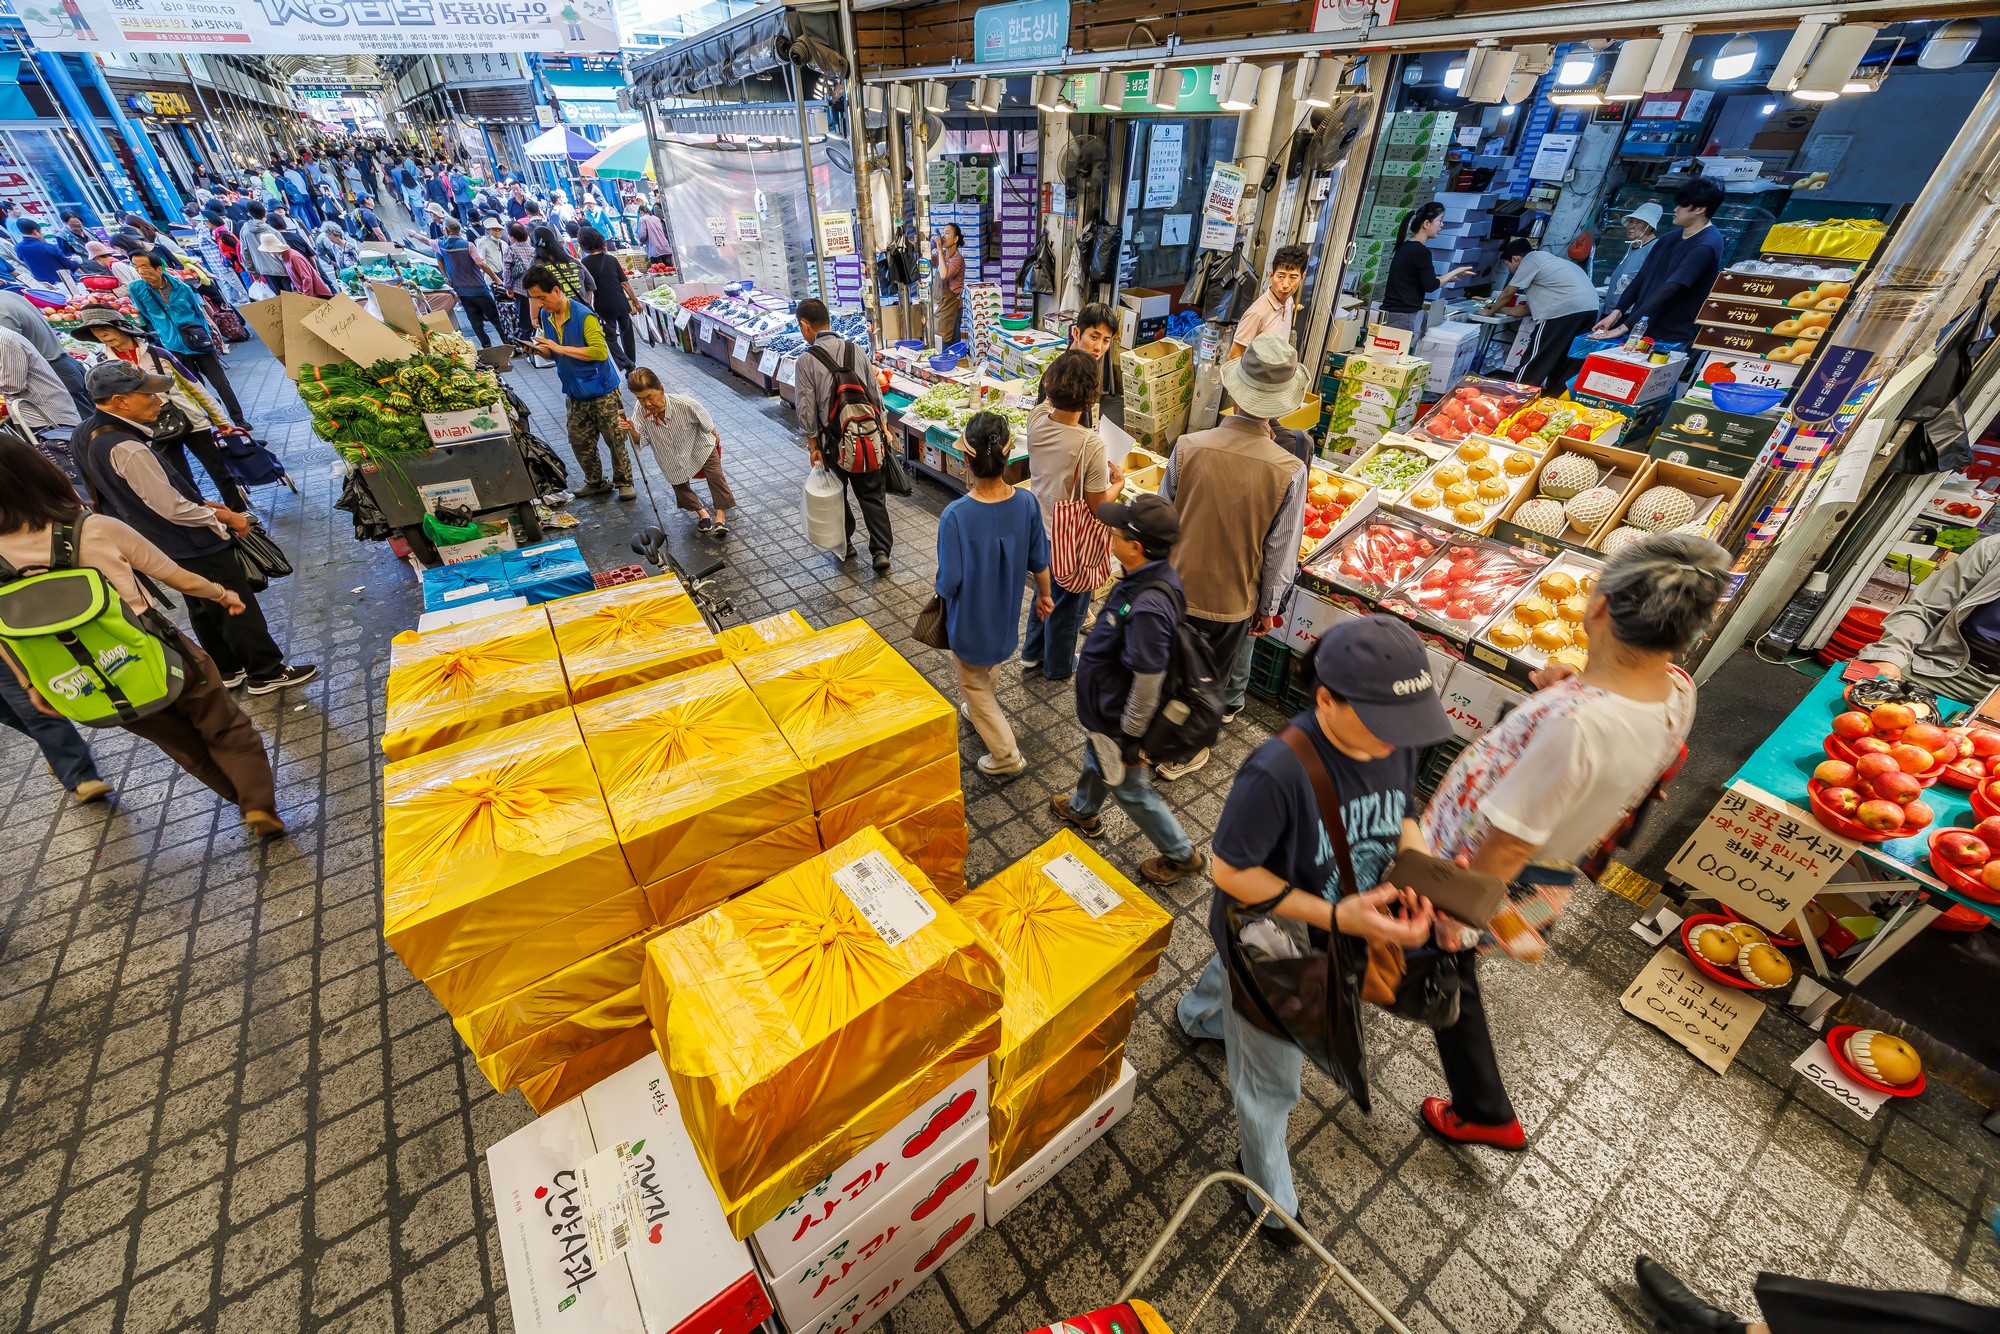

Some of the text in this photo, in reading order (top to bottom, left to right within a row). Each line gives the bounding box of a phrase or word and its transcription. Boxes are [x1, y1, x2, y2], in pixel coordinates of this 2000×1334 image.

[1008, 12, 1059, 45] 한도상사
[826, 237, 850, 247] 참여점포
[1374, 340, 1399, 350] Supreme
[1751, 375, 1782, 389] 사과
[441, 425, 473, 437] 시금치
[1311, 580, 1331, 595] 사과
[1446, 707, 1484, 730] 사과
[1720, 793, 1845, 864] 햇 홍로 꿀사과
[622, 1141, 630, 1150] SS
[625, 1151, 634, 1162] 102
[630, 1174, 639, 1186] 163
[791, 1160, 891, 1242] 사과
[545, 1169, 598, 1294] 단양사과
[812, 1225, 901, 1299] 사과
[833, 1277, 905, 1334] 사과
